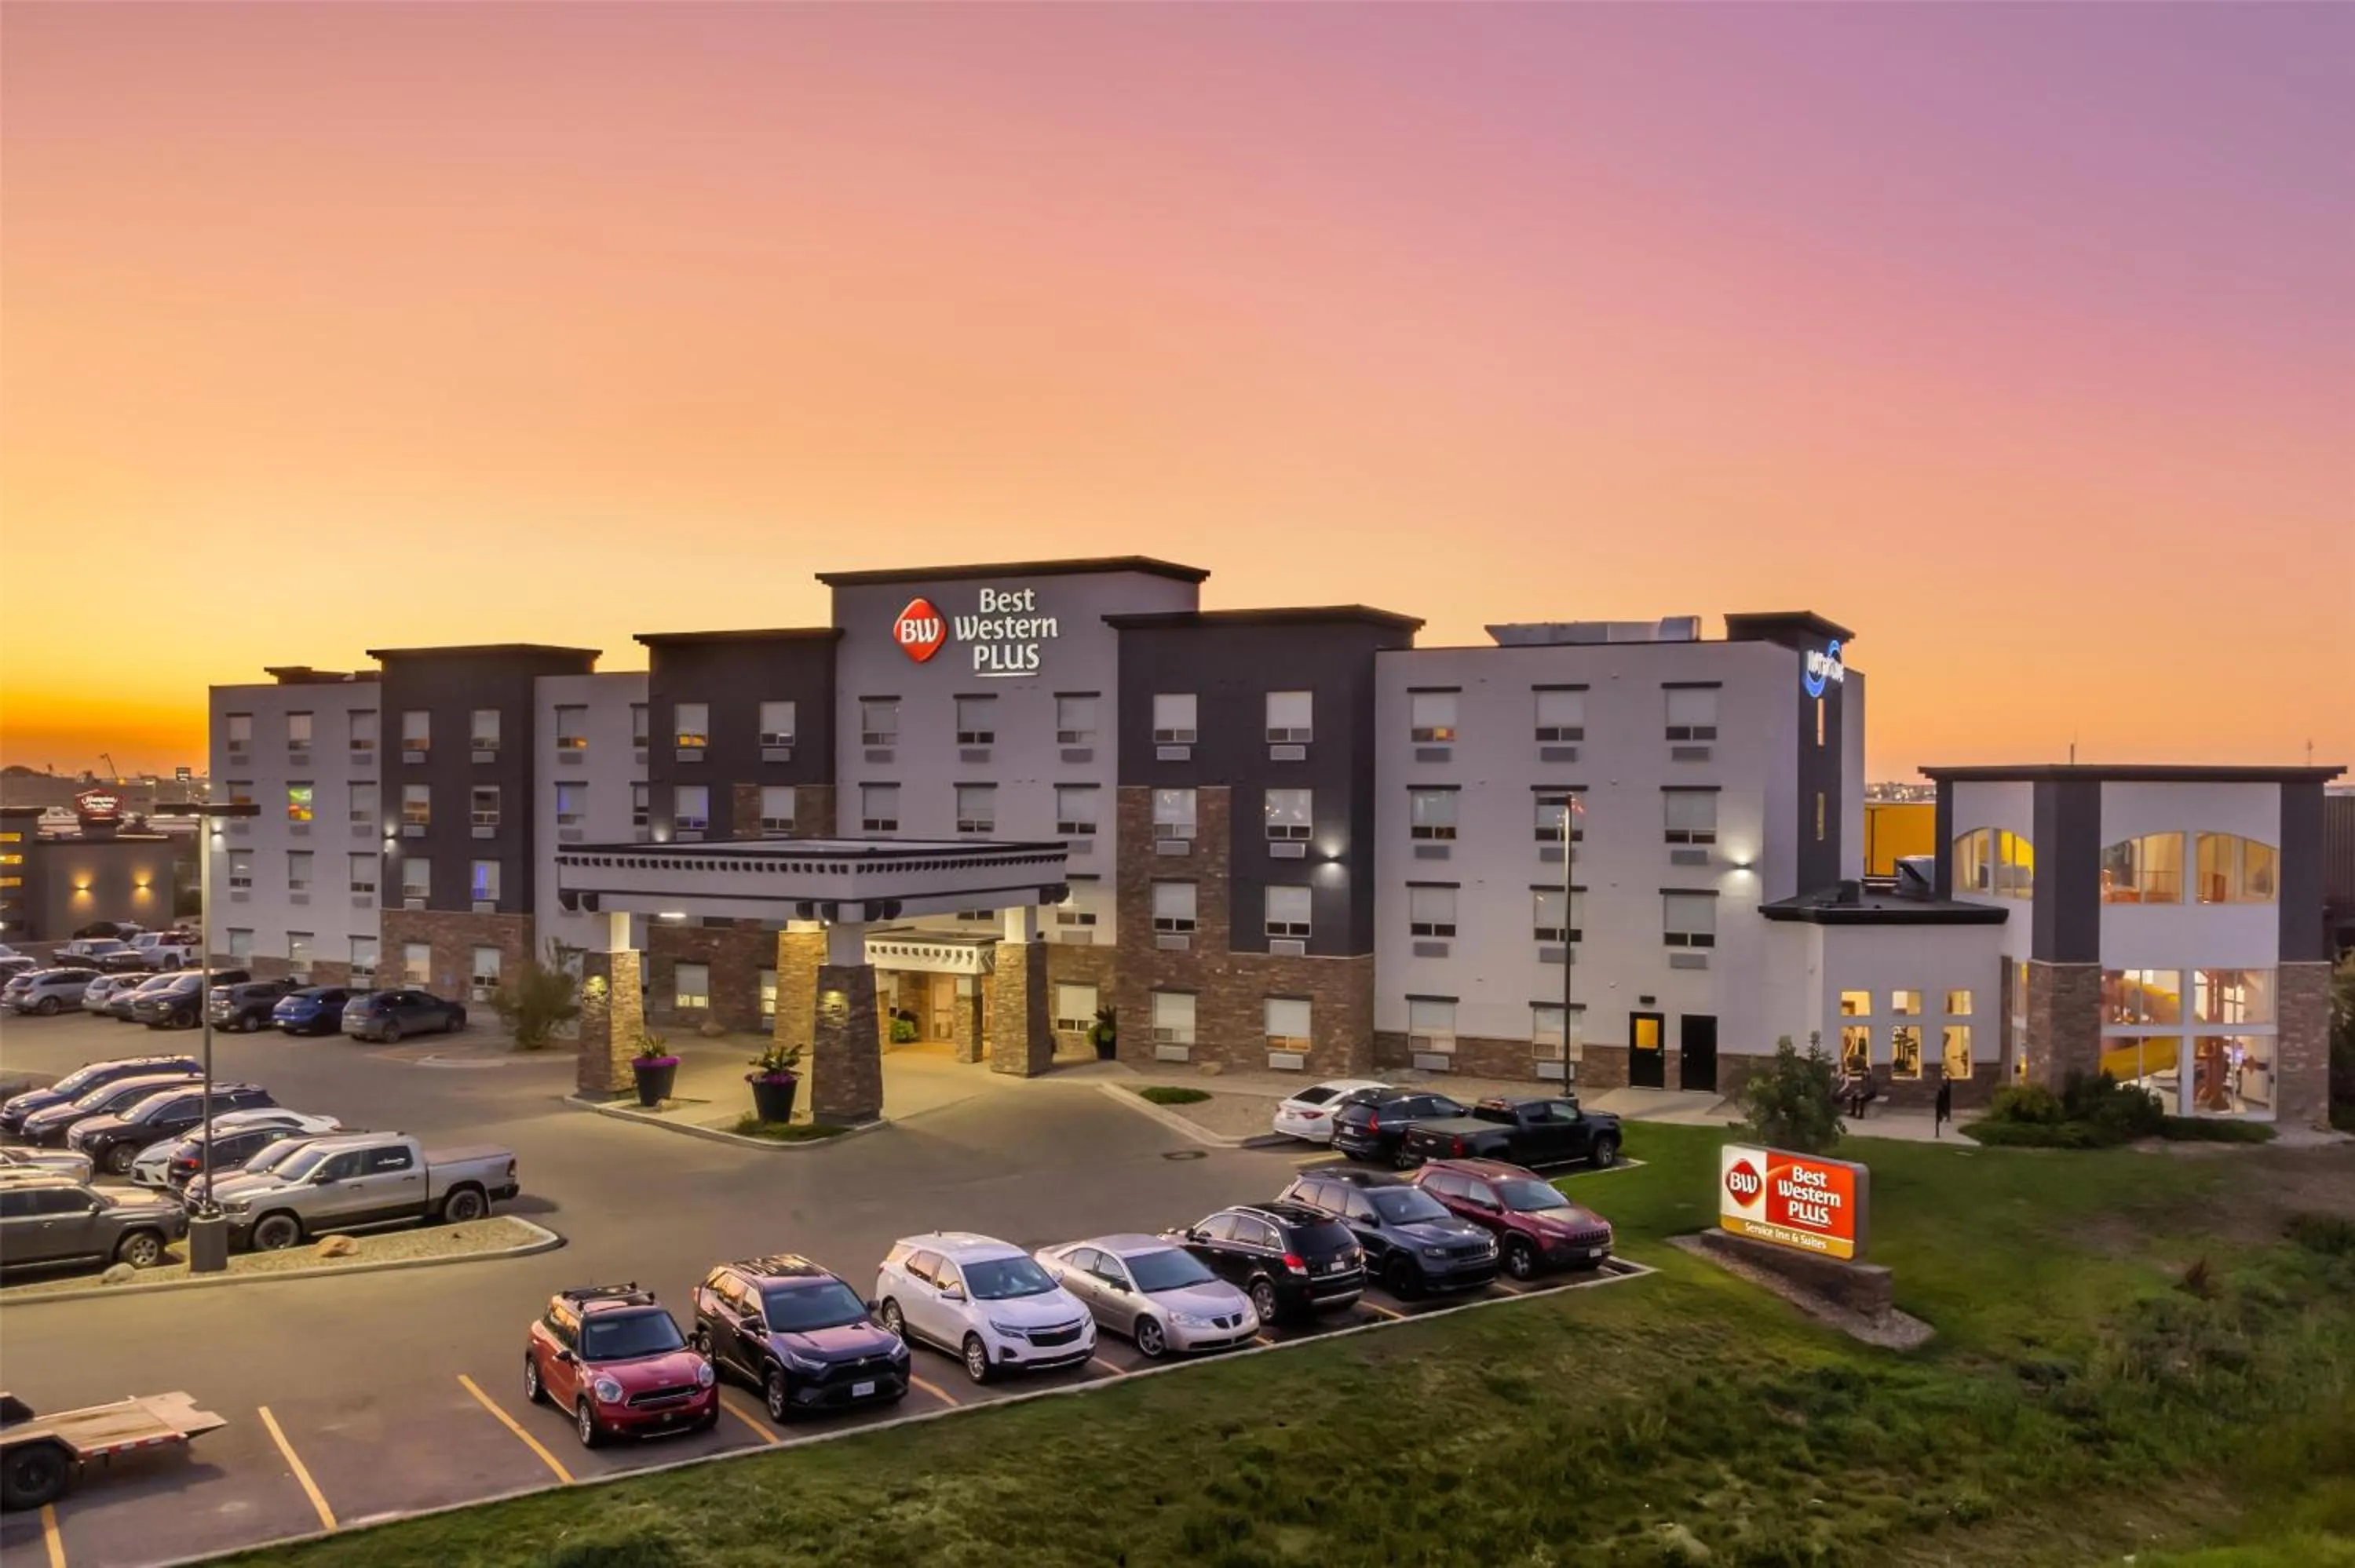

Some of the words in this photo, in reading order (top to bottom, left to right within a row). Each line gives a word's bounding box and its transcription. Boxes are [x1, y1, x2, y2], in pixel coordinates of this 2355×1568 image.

[980, 588, 1035, 613] Best
[900, 618, 939, 644] BW
[955, 615, 1059, 641] Western
[973, 644, 1040, 670] PLUS
[1729, 1172, 1758, 1194] BW
[1792, 1165, 1827, 1187] Best
[1777, 1180, 1842, 1208] Western
[1788, 1202, 1830, 1224] PLUS
[1745, 1222, 1773, 1236] Service
[1775, 1229, 1791, 1241] Inn
[1791, 1233, 1798, 1243] &
[1800, 1235, 1827, 1249] Suites
